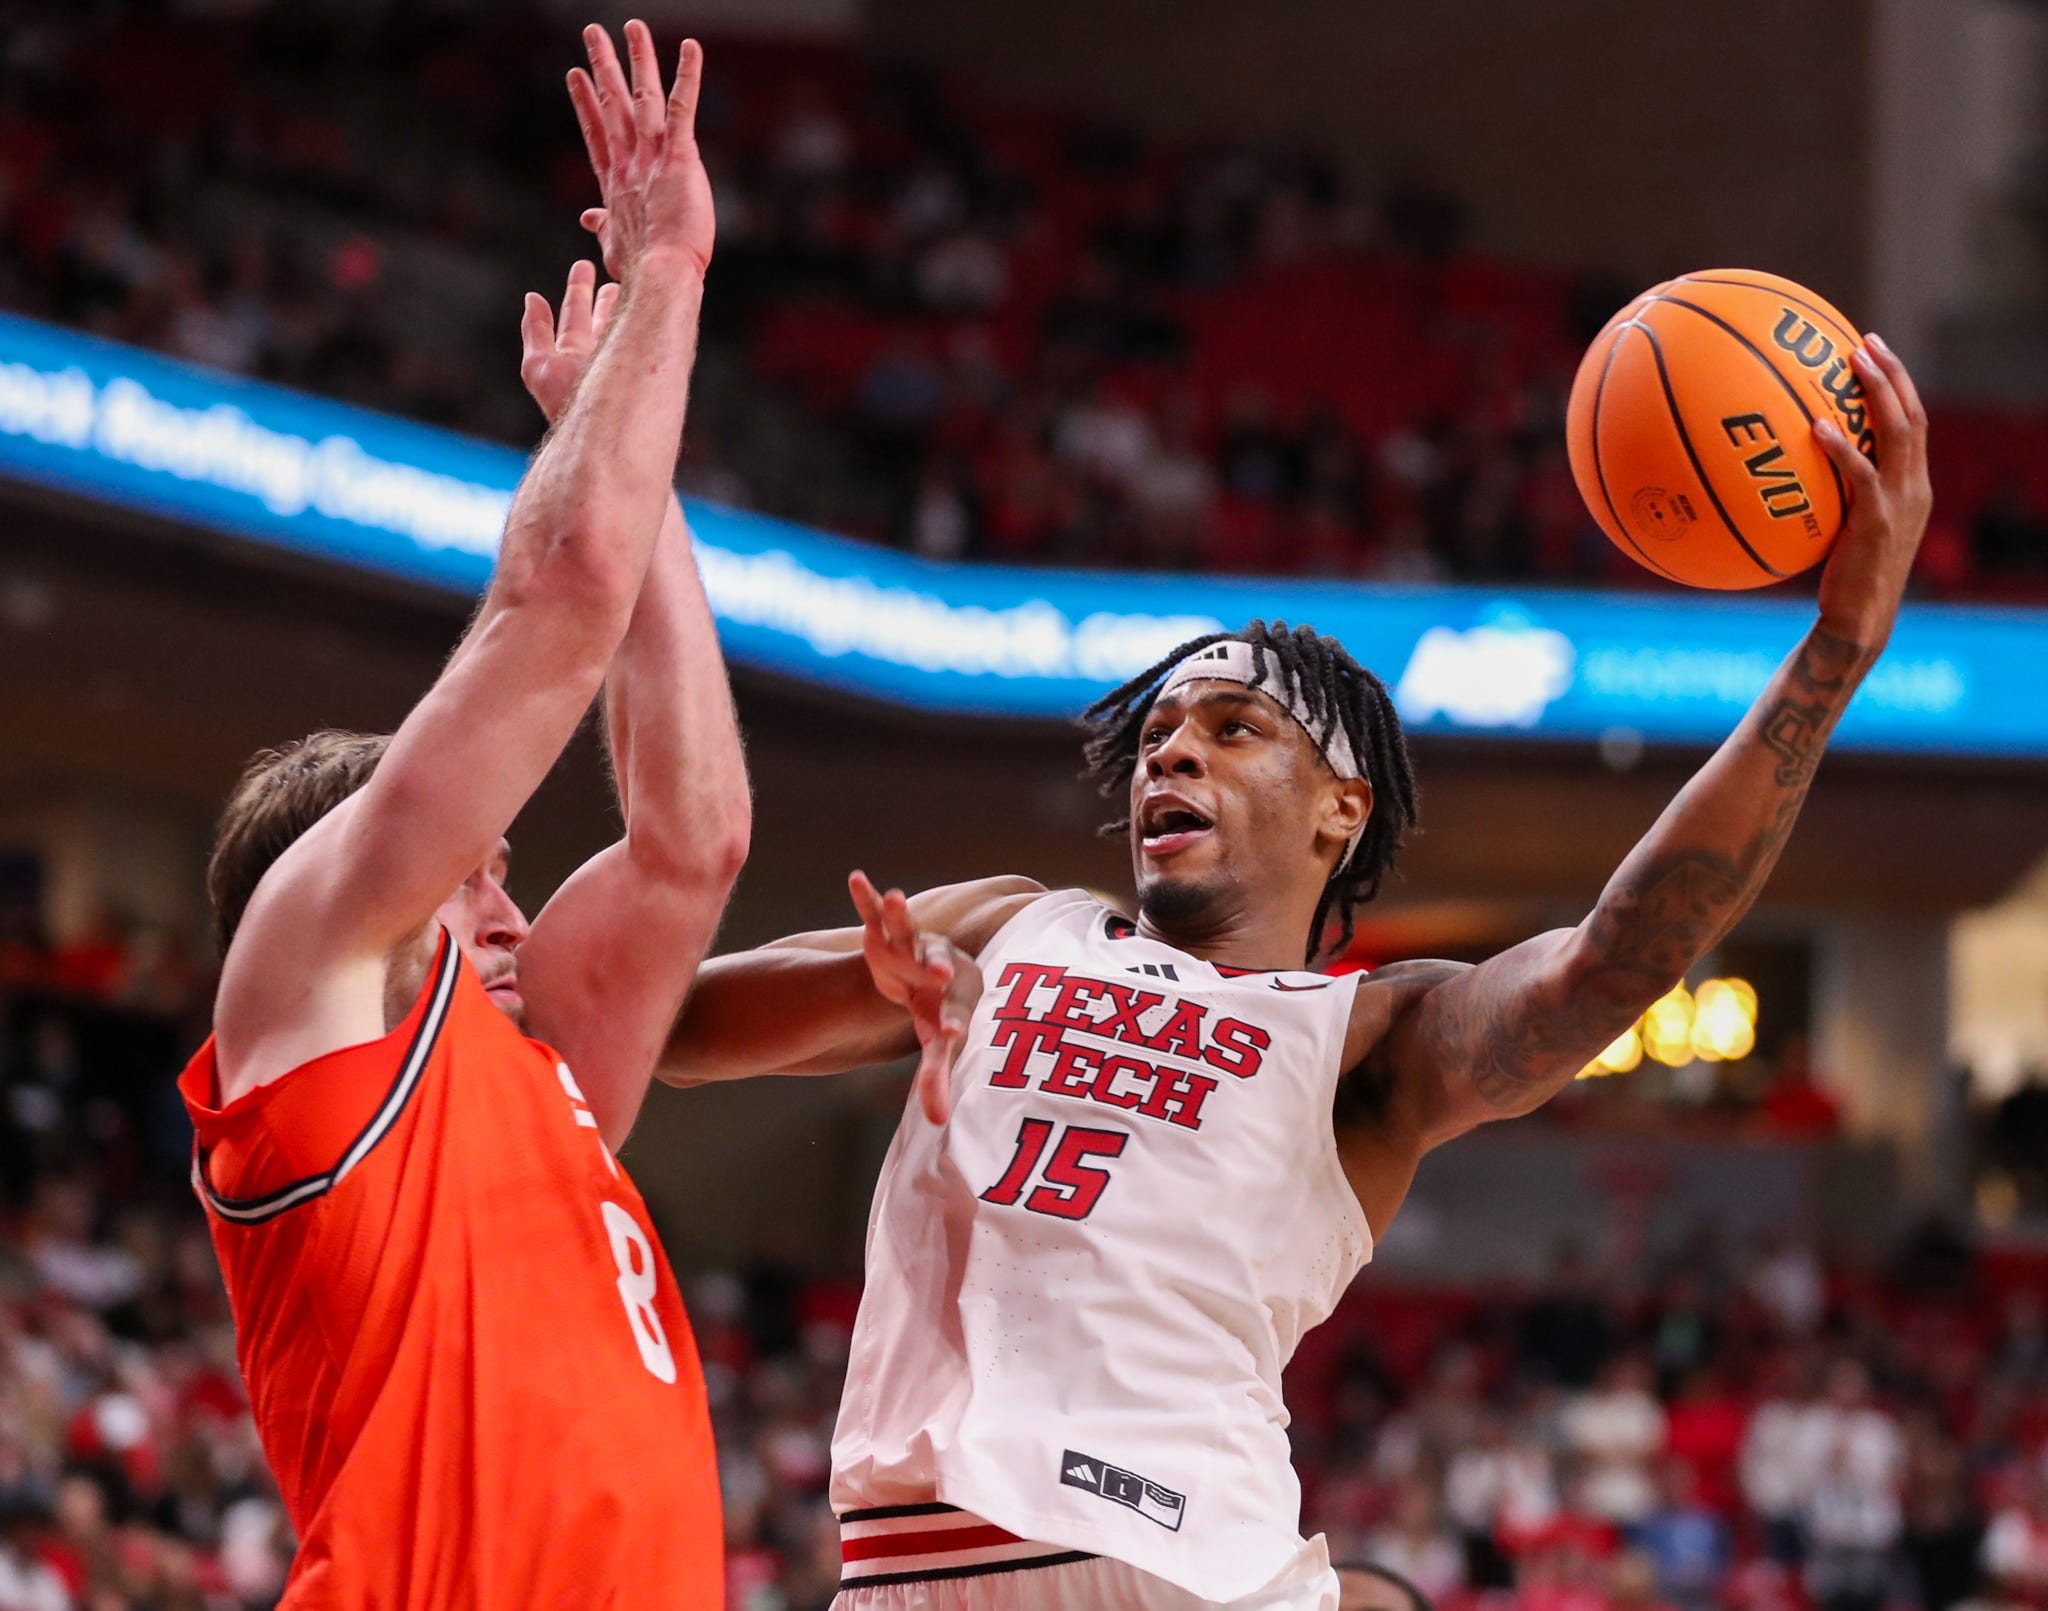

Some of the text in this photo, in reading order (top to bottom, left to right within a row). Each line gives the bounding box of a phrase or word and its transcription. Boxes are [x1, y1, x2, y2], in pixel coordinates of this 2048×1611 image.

[1721, 412, 1811, 518] EVO
[989, 1018, 1218, 1130] TECH
[992, 963, 1271, 1079] TEXAS
[978, 1117, 1129, 1220] 15
[601, 1201, 677, 1384] 8
